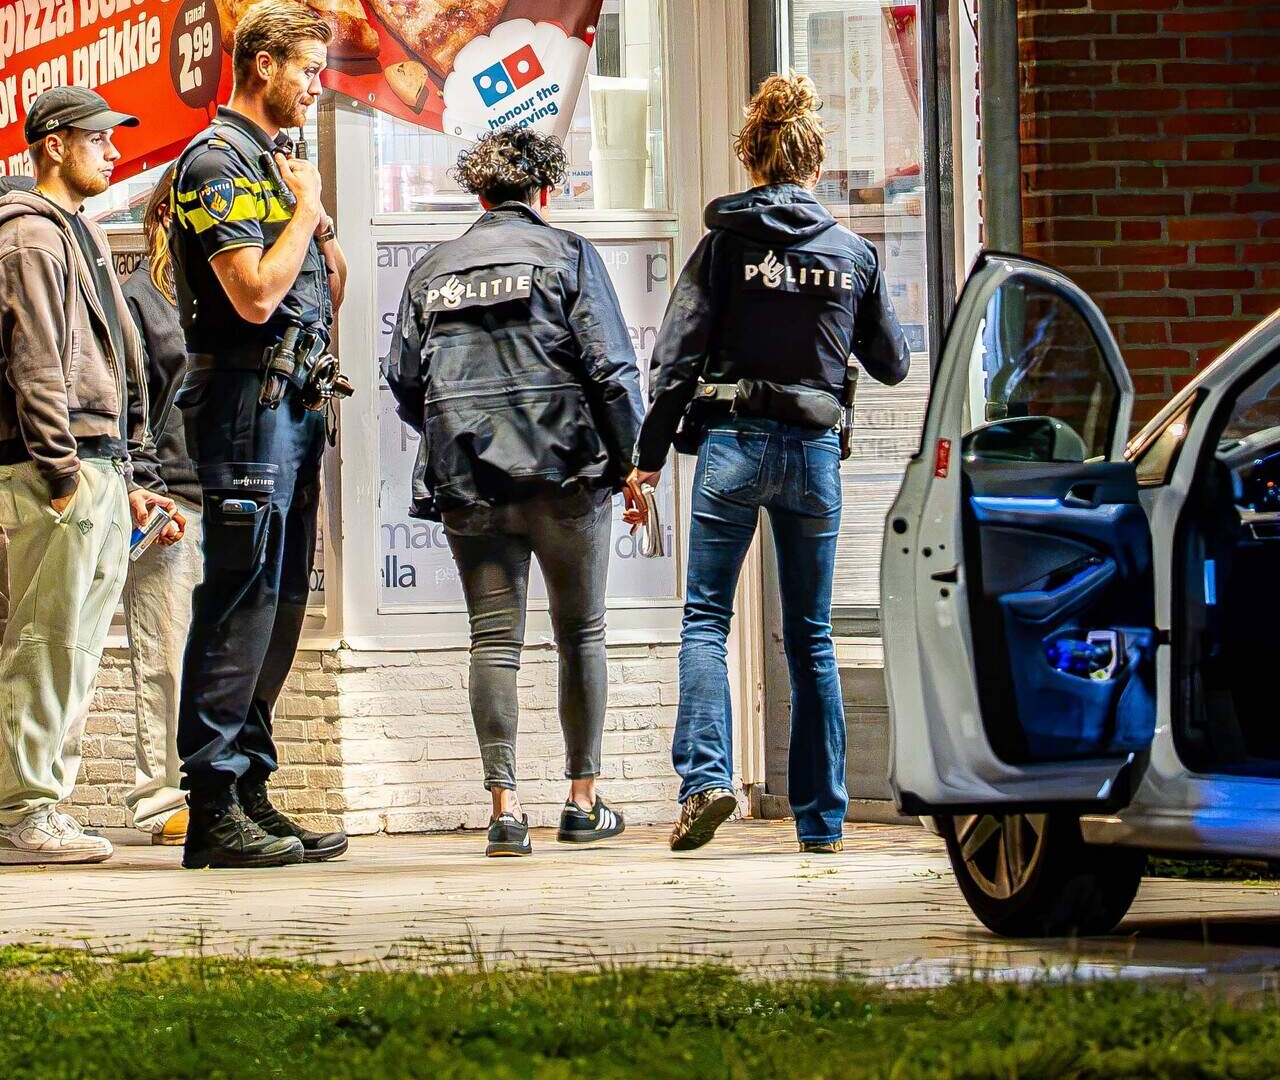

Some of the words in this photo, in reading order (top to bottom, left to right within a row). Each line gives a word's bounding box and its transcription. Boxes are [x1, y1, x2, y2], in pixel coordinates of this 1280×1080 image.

[185, 1, 205, 26] vanaf
[21, 55, 67, 114] een
[72, 11, 161, 89] prikkie
[487, 96, 534, 130] honour
[536, 83, 560, 101] the
[513, 101, 559, 129] aving
[744, 254, 853, 290] POLITIE
[426, 275, 531, 307] POLITIE
